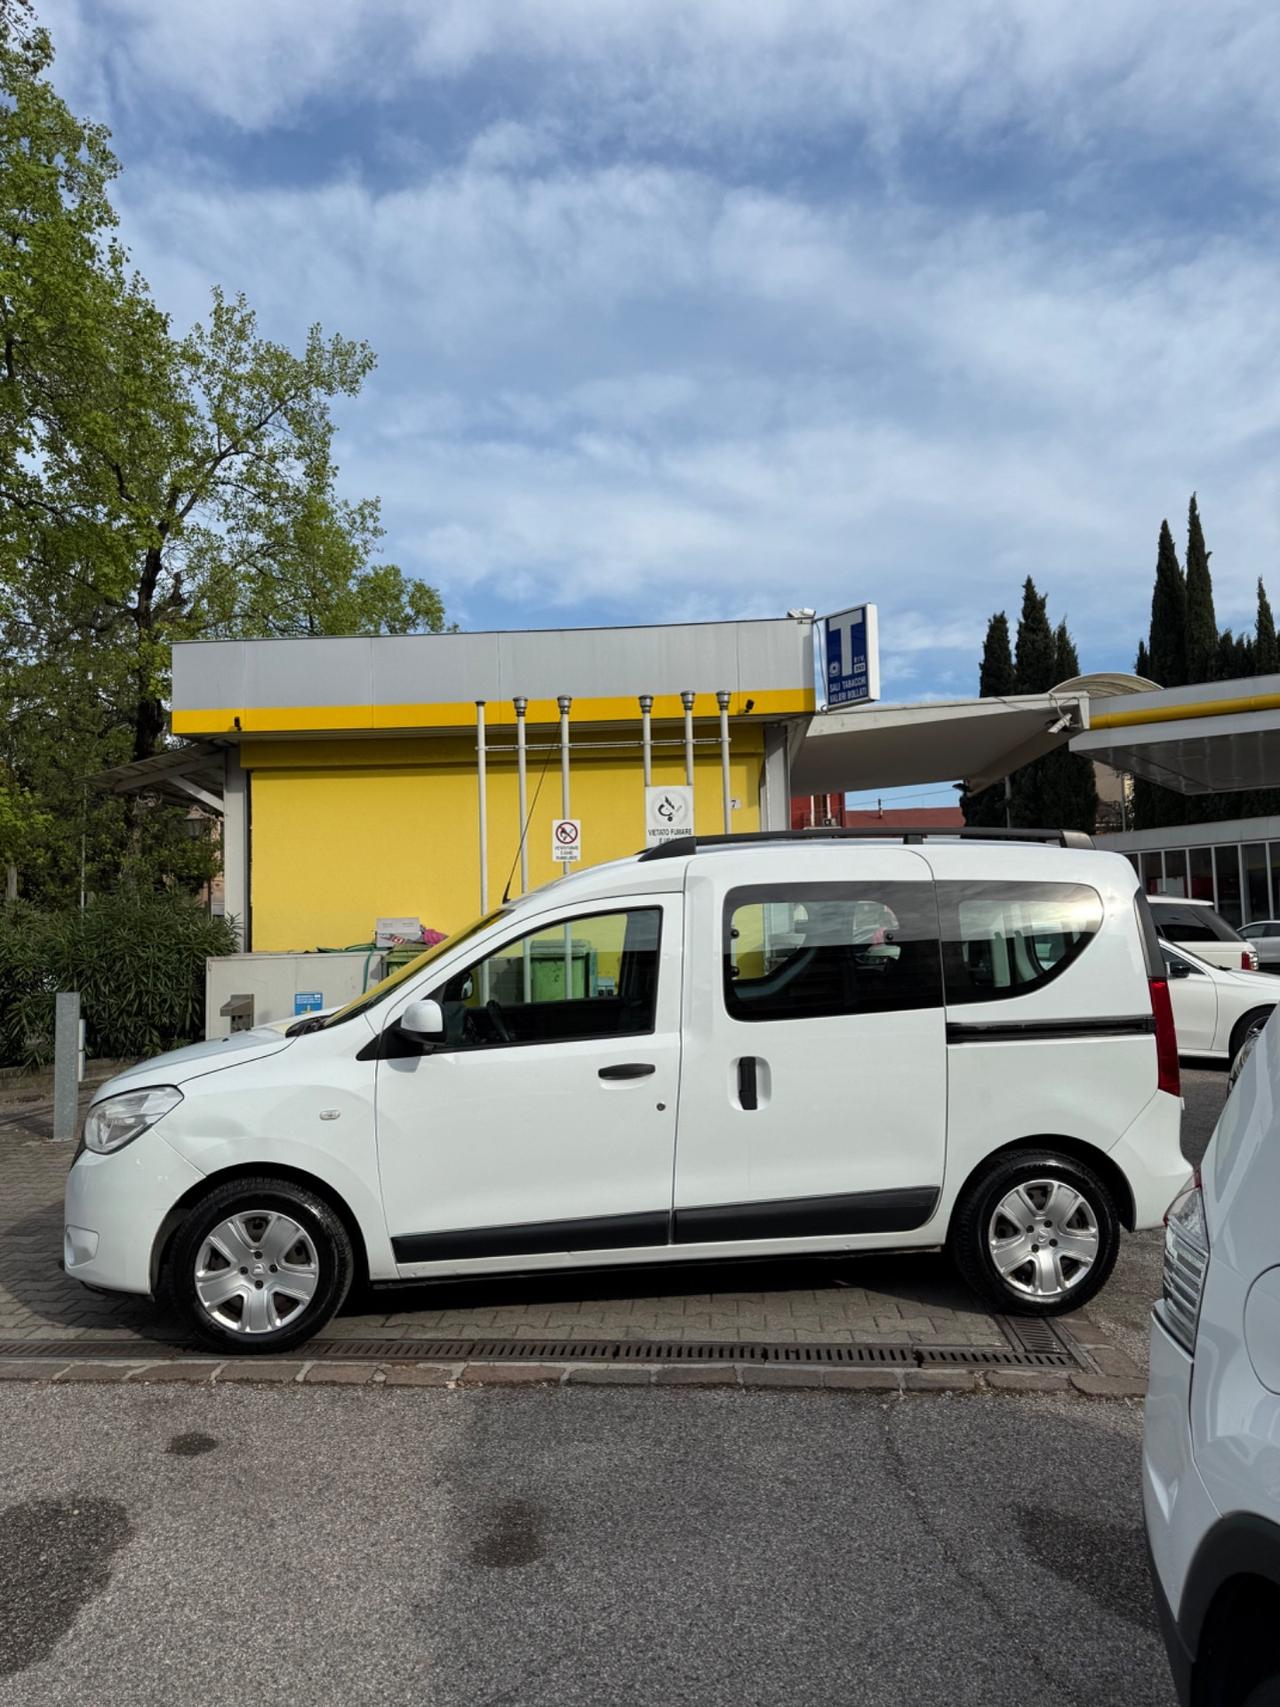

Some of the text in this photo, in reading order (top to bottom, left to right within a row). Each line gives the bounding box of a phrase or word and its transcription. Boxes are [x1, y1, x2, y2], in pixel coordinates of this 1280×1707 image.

[829, 609, 863, 676] T
[648, 828, 692, 836] VIETATO FUMARE
